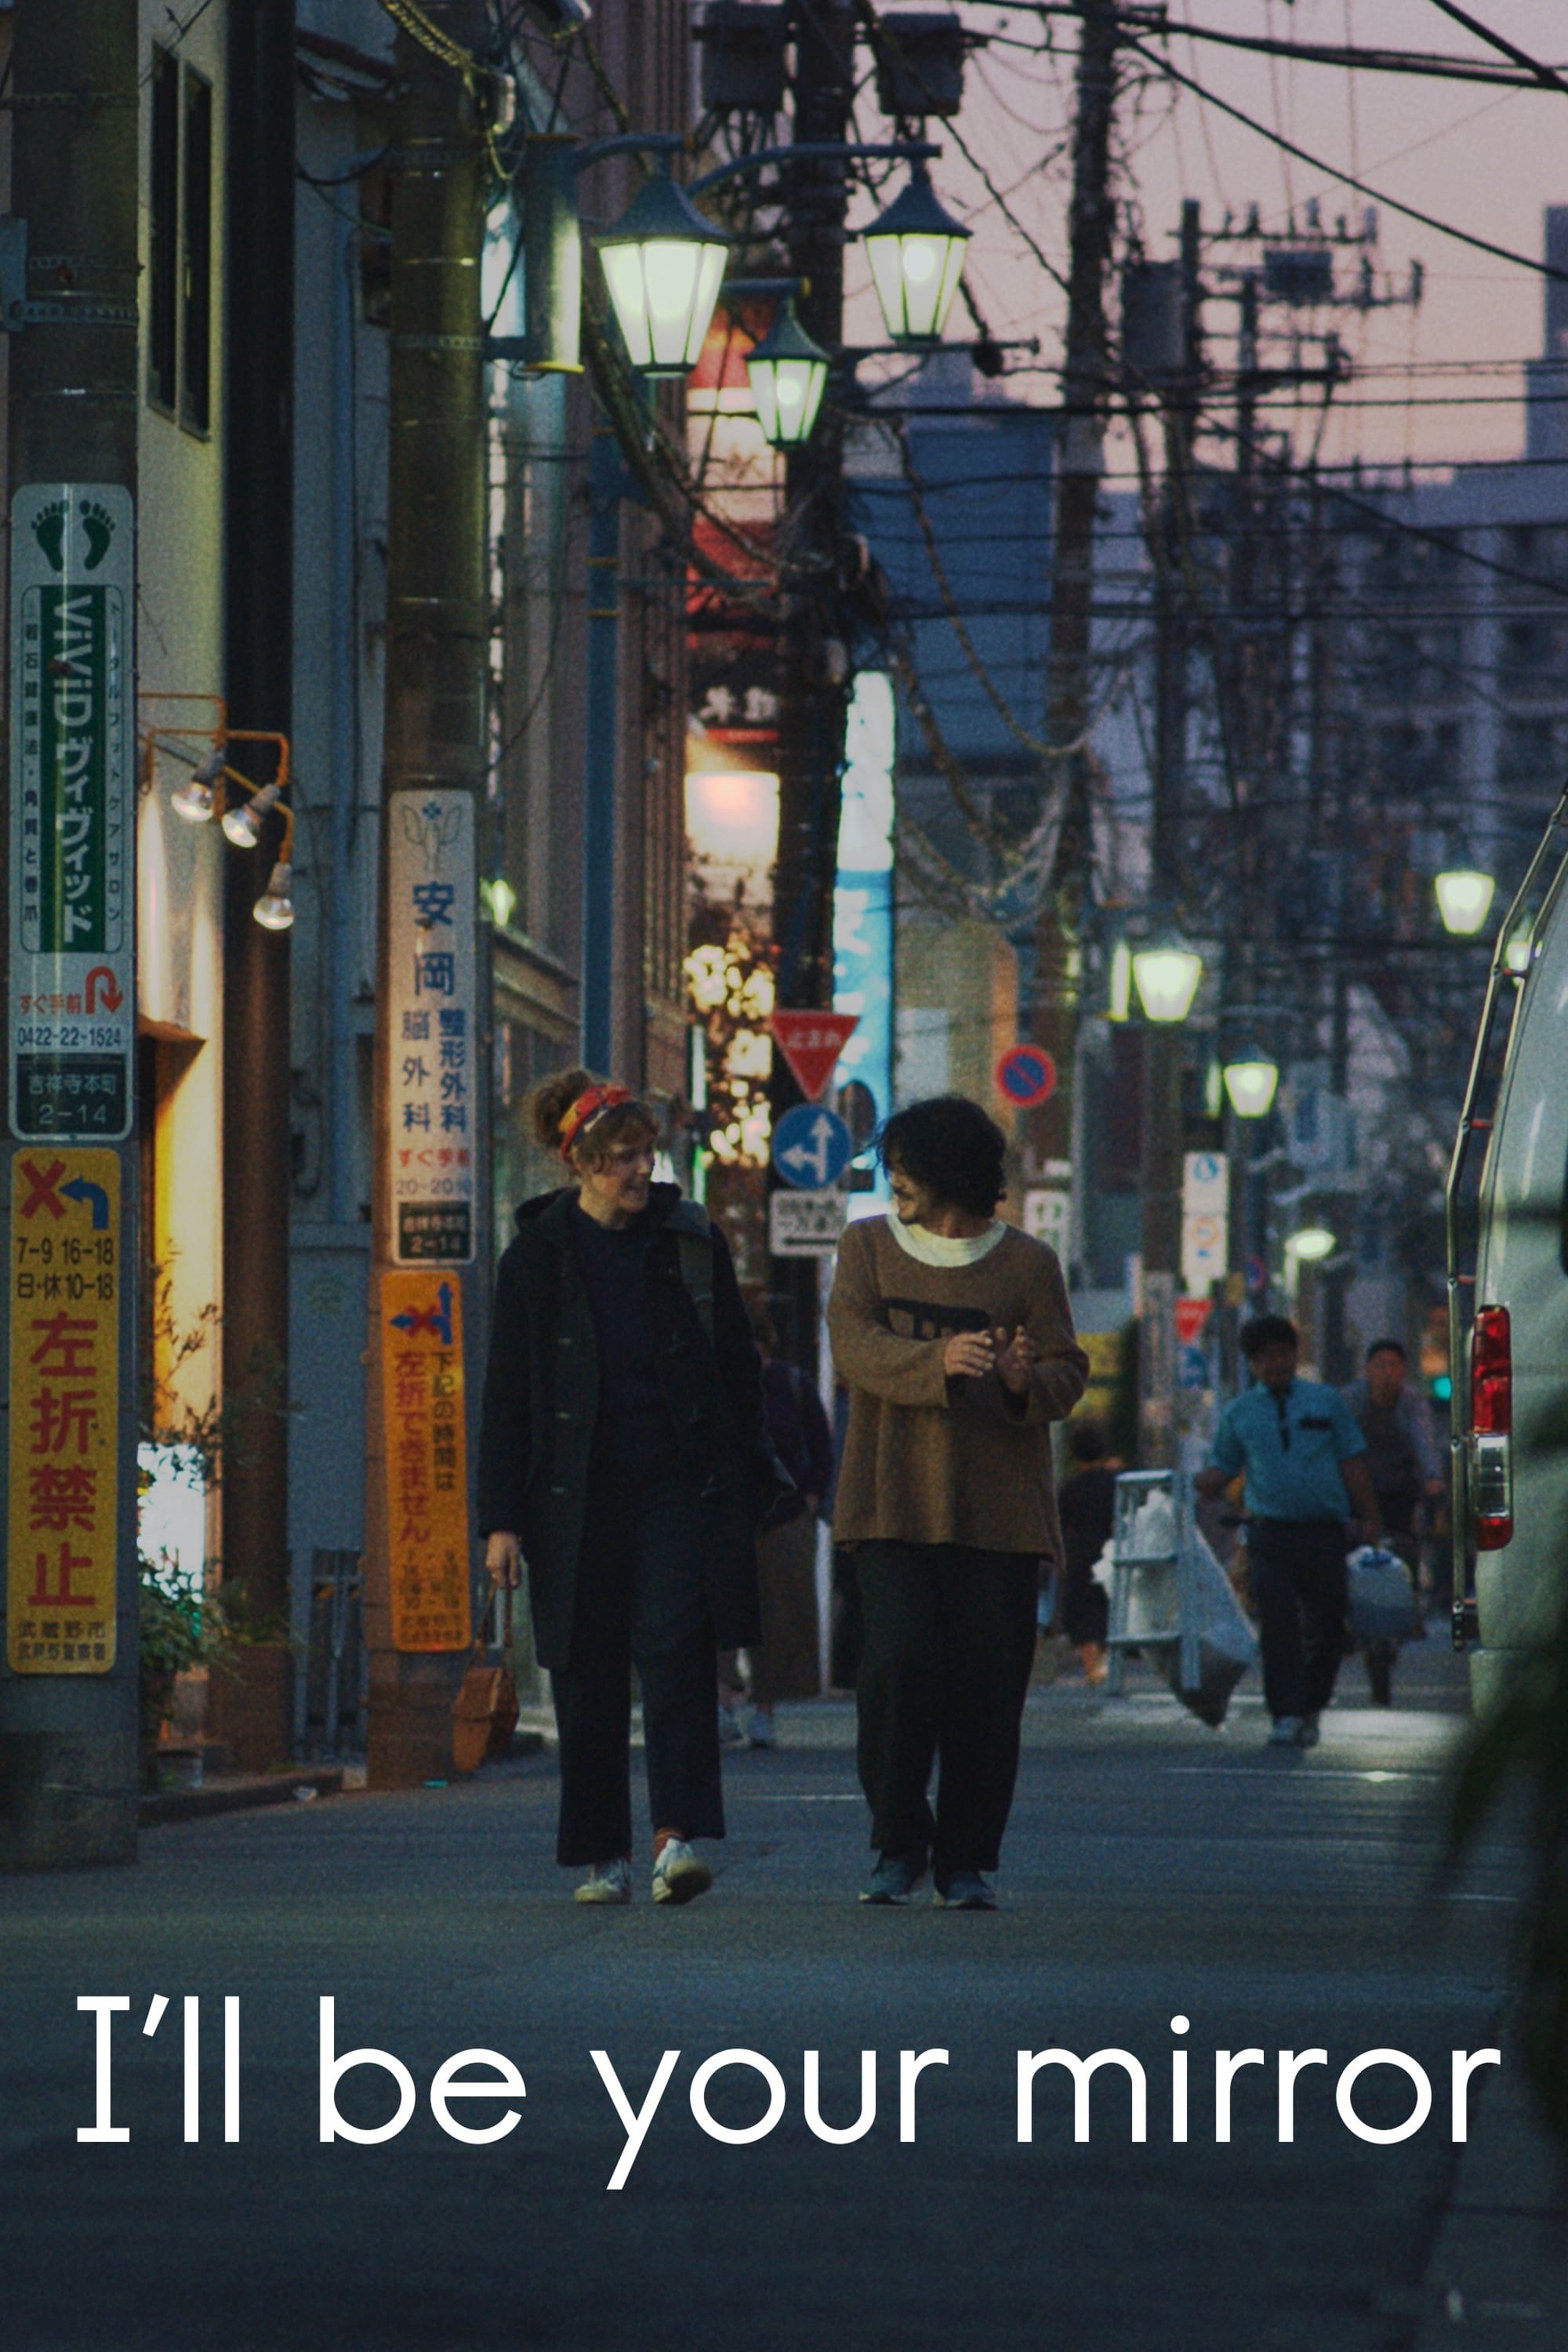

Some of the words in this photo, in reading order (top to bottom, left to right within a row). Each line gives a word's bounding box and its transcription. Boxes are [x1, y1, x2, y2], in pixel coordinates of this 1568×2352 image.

[412, 880, 455, 996] 安岡
[20, 994, 82, 1015] すぐ手前
[17, 1026, 122, 1047] 0422-22-1524
[28, 1073, 118, 1095] 吉祥寺本町
[440, 1008, 466, 1134] 整形外科
[16, 1236, 53, 1265] 7-9
[61, 1236, 114, 1265] 16-18
[65, 1272, 114, 1301] 10-18
[28, 1310, 100, 1607] 左折禁止
[394, 1350, 430, 1542] 左折できません
